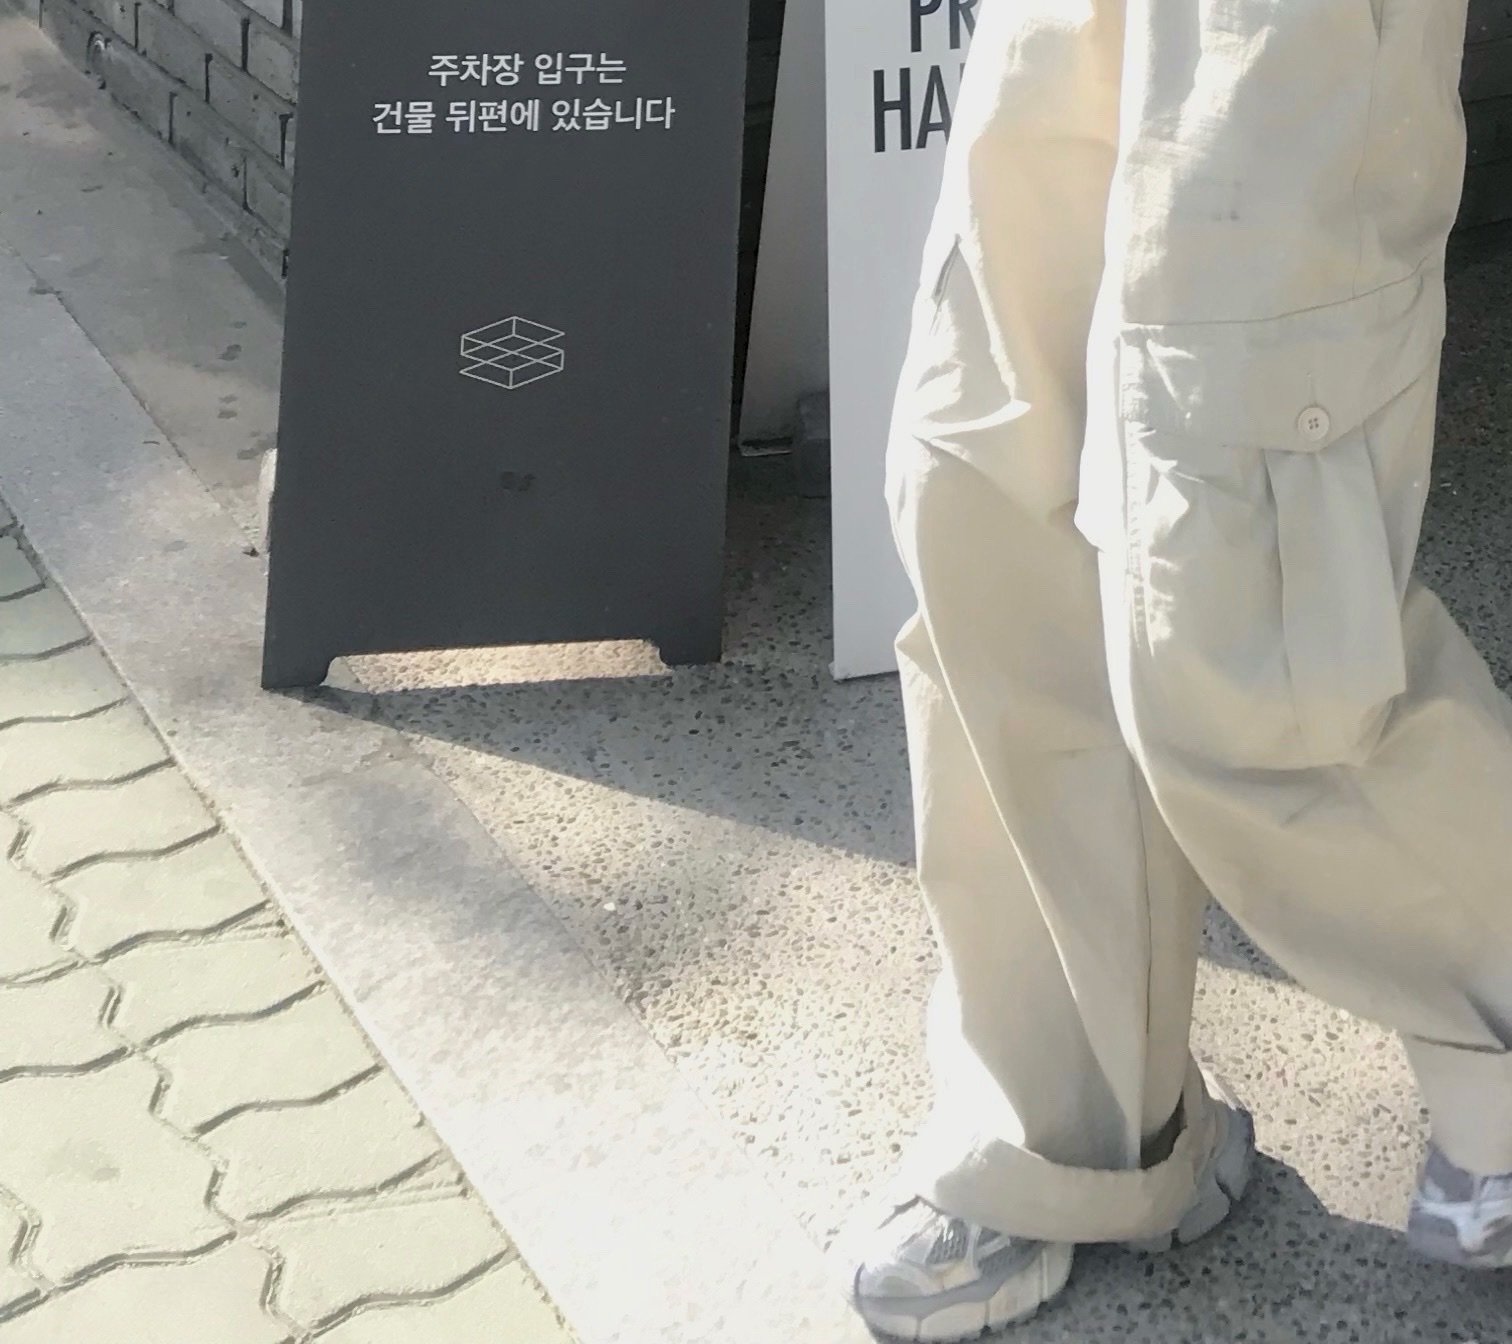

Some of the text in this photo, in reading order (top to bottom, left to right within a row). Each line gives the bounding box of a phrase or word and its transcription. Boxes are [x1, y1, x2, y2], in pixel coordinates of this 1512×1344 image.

[428, 52, 627, 86] 주차장 입구는
[372, 96, 676, 134] 건물 뒤편에 있습니다
[873, 62, 967, 153] HA
